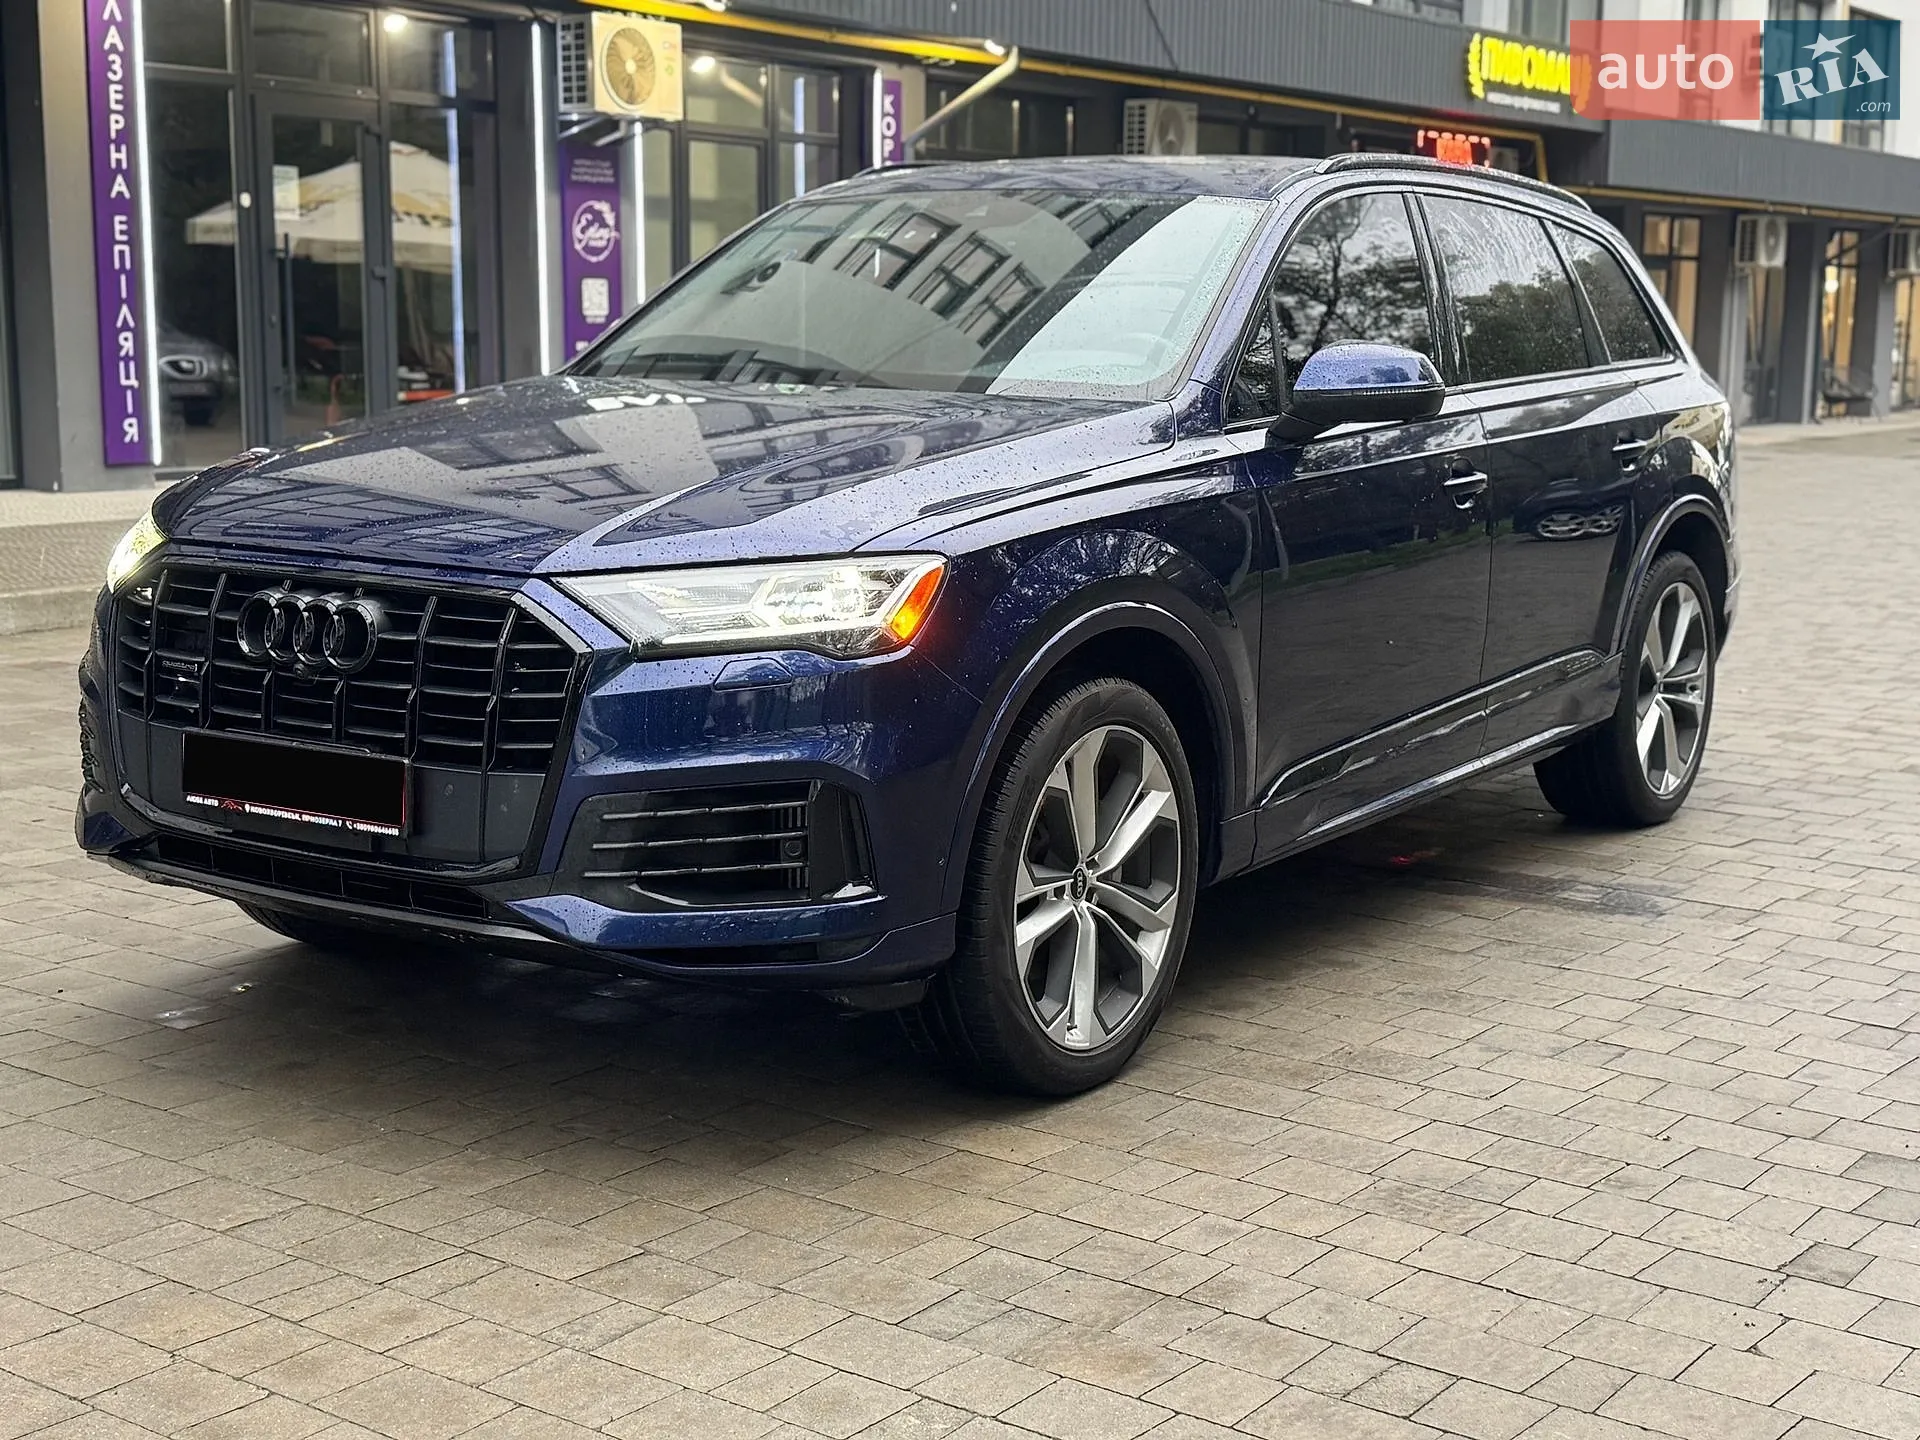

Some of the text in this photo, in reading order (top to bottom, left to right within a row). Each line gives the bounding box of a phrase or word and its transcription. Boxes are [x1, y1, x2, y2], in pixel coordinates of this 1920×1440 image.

[102, 0, 139, 443] ЛАЗЕРНА ЕПІЛЯЦІЯ
[882, 93, 897, 165] КОР
